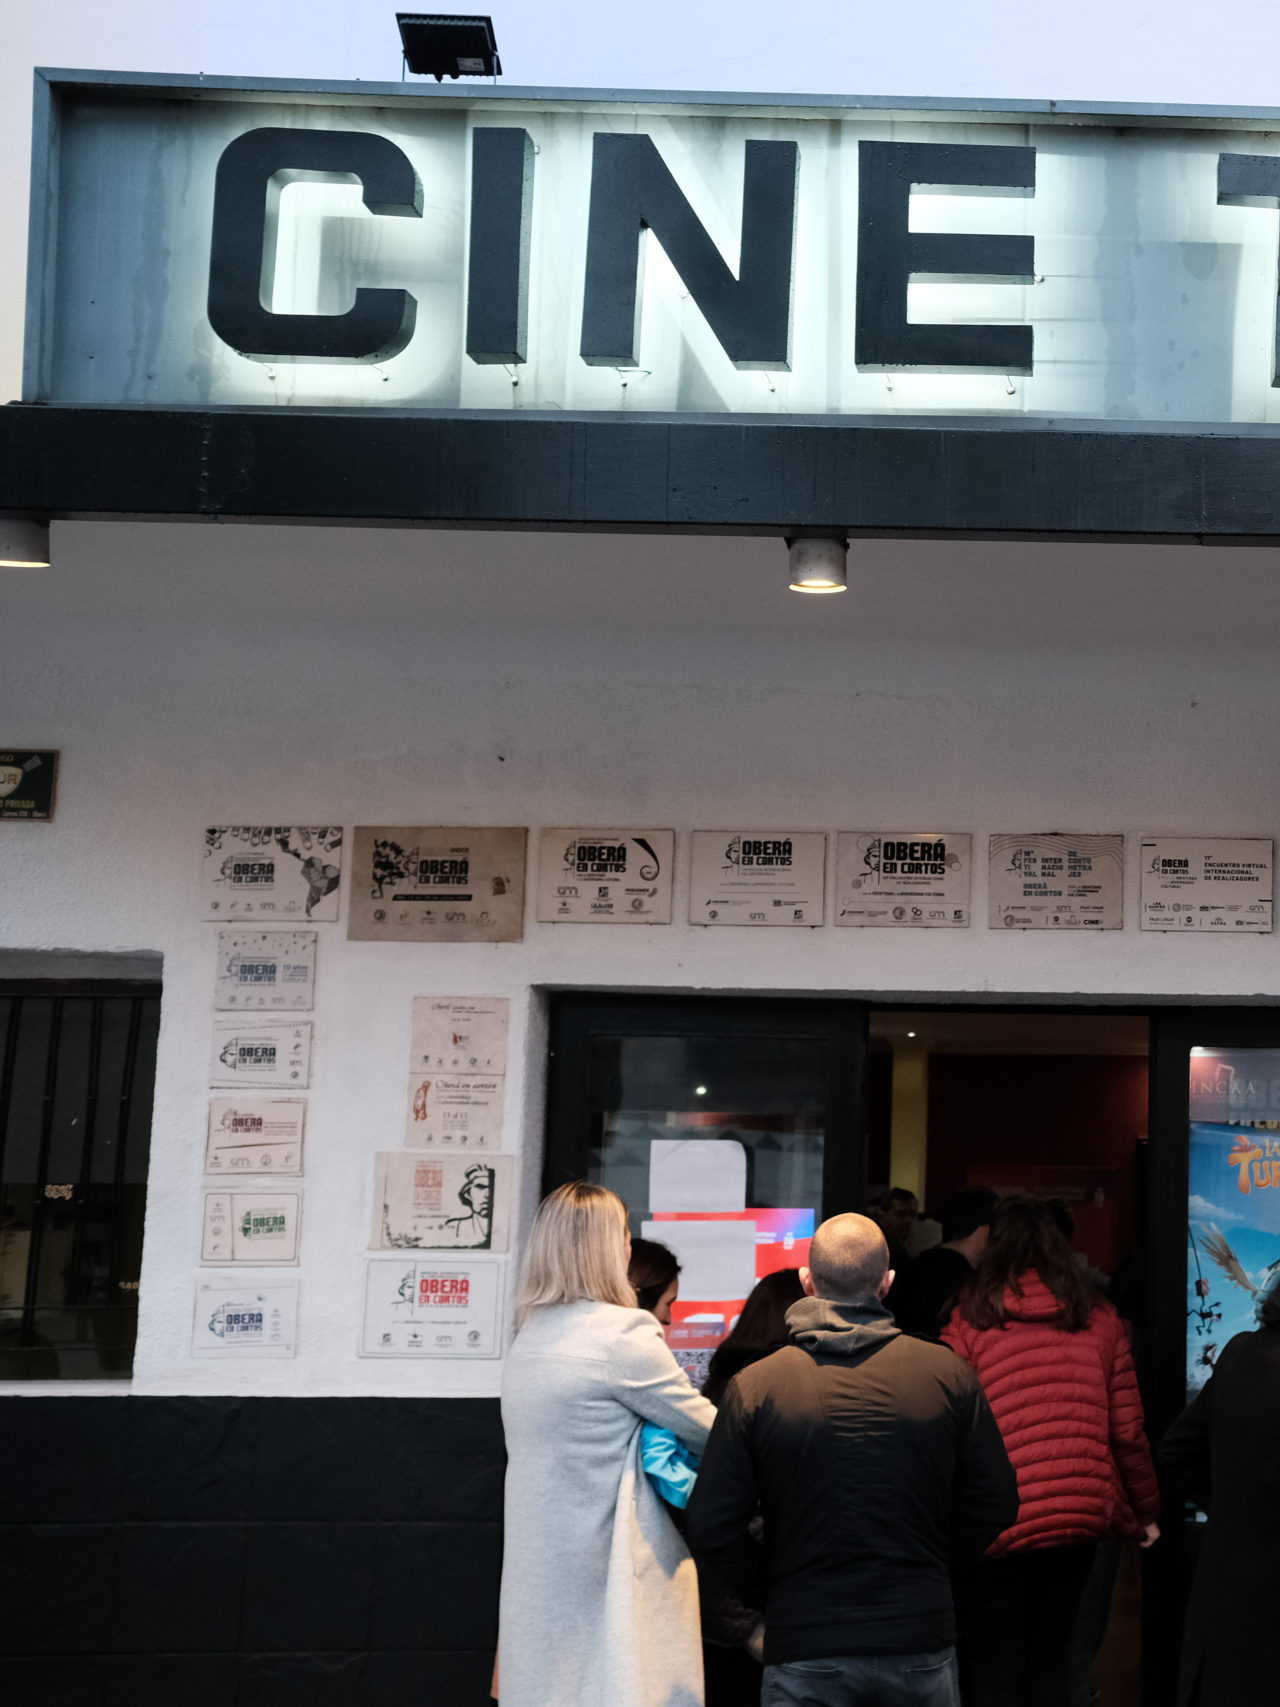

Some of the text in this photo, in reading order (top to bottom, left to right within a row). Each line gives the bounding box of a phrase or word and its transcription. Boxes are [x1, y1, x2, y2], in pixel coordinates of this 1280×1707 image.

[208, 126, 1036, 376] CINE
[577, 843, 627, 862] OBERÁ
[742, 837, 793, 856] OBERÁ
[883, 838, 946, 861] OBERÁ
[233, 861, 275, 875] OBERÁ
[419, 857, 469, 875] OBERÁ
[576, 862, 626, 873] EN CORTOS
[741, 856, 792, 866] EN CORTOS
[882, 862, 945, 875] EN CORTOS
[1161, 857, 1189, 868] OBERÁ
[419, 875, 469, 885] EN CORTOS
[1191, 1080, 1257, 1096] INCAA
[1265, 1138, 1280, 1157] LA
[419, 1276, 469, 1294] OBERÁ
[418, 1294, 469, 1305] EN CORTOS
